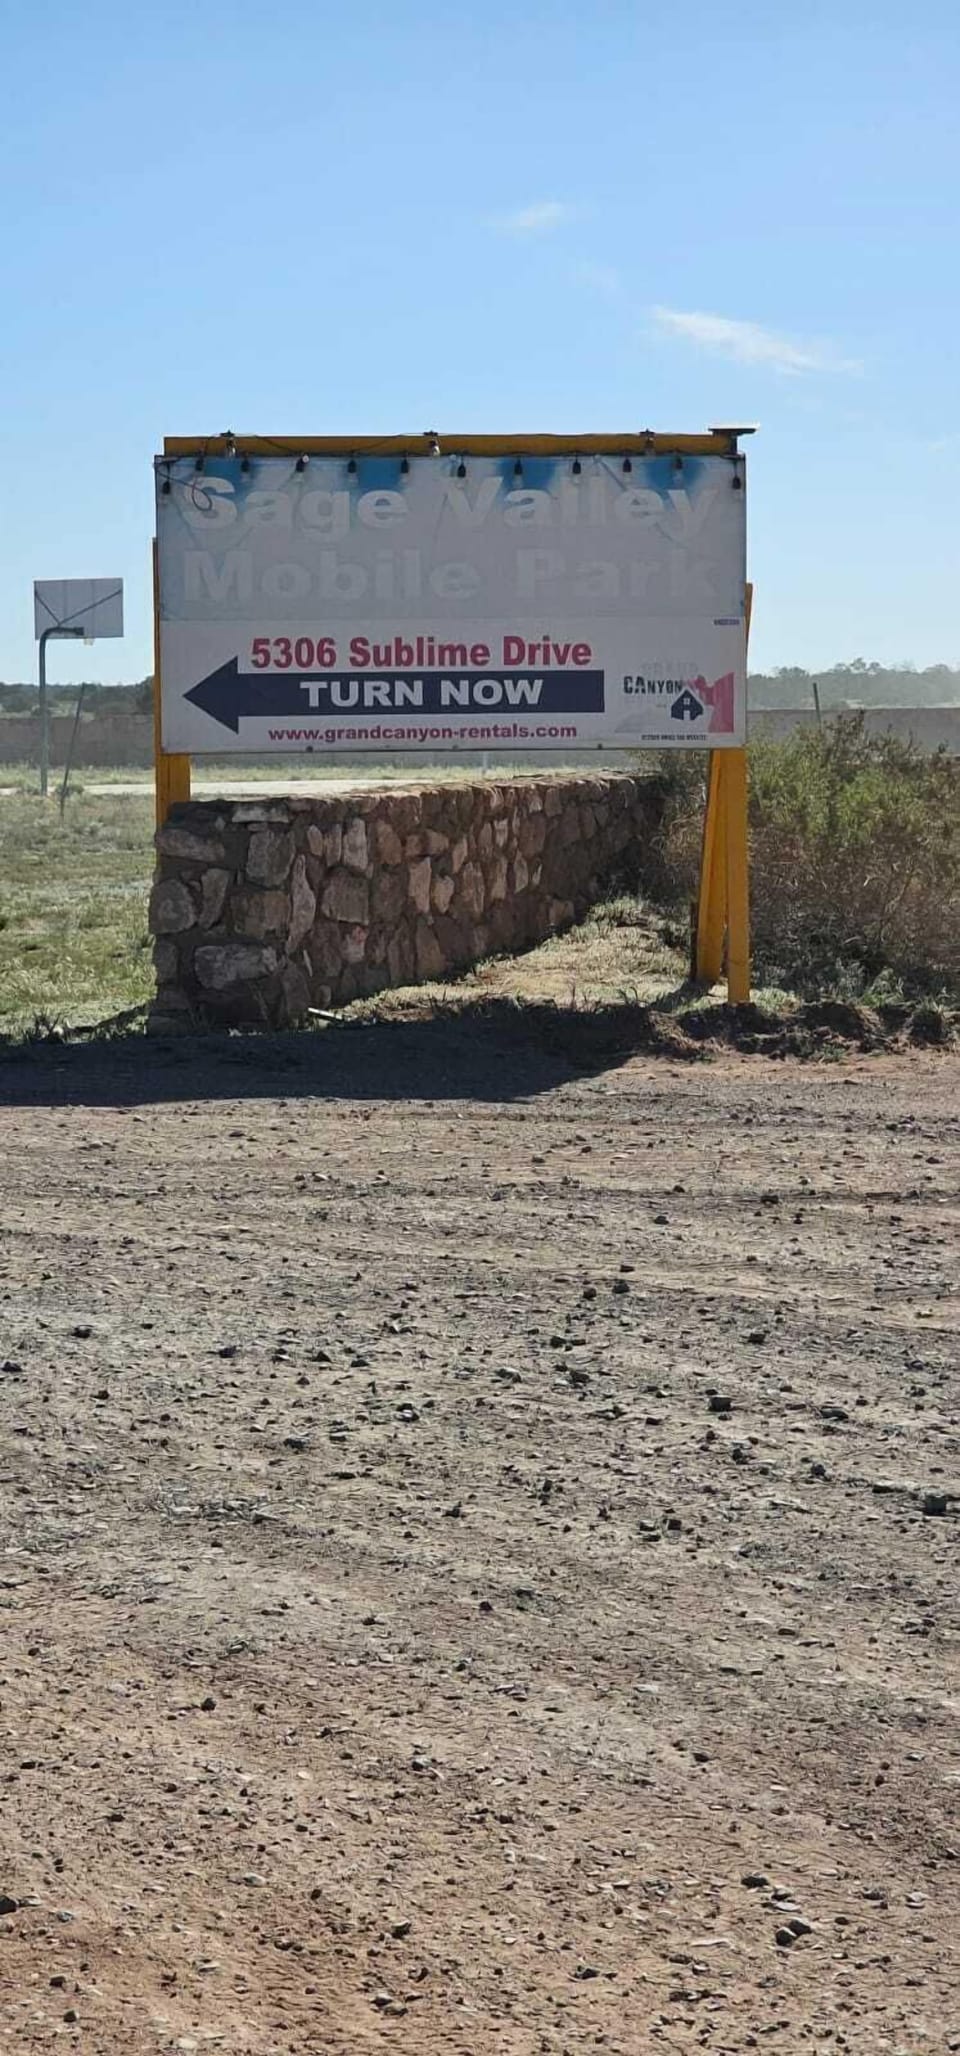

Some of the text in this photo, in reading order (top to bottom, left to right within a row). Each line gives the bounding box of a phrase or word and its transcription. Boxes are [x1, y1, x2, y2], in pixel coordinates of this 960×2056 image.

[183, 476, 720, 544] Sage Valley
[184, 548, 720, 600] Mobile Park
[251, 635, 592, 669] 5306 Sublime Drive
[300, 679, 544, 708] TURN NOW
[268, 723, 578, 743] www.grandcanyon-rentals.com
